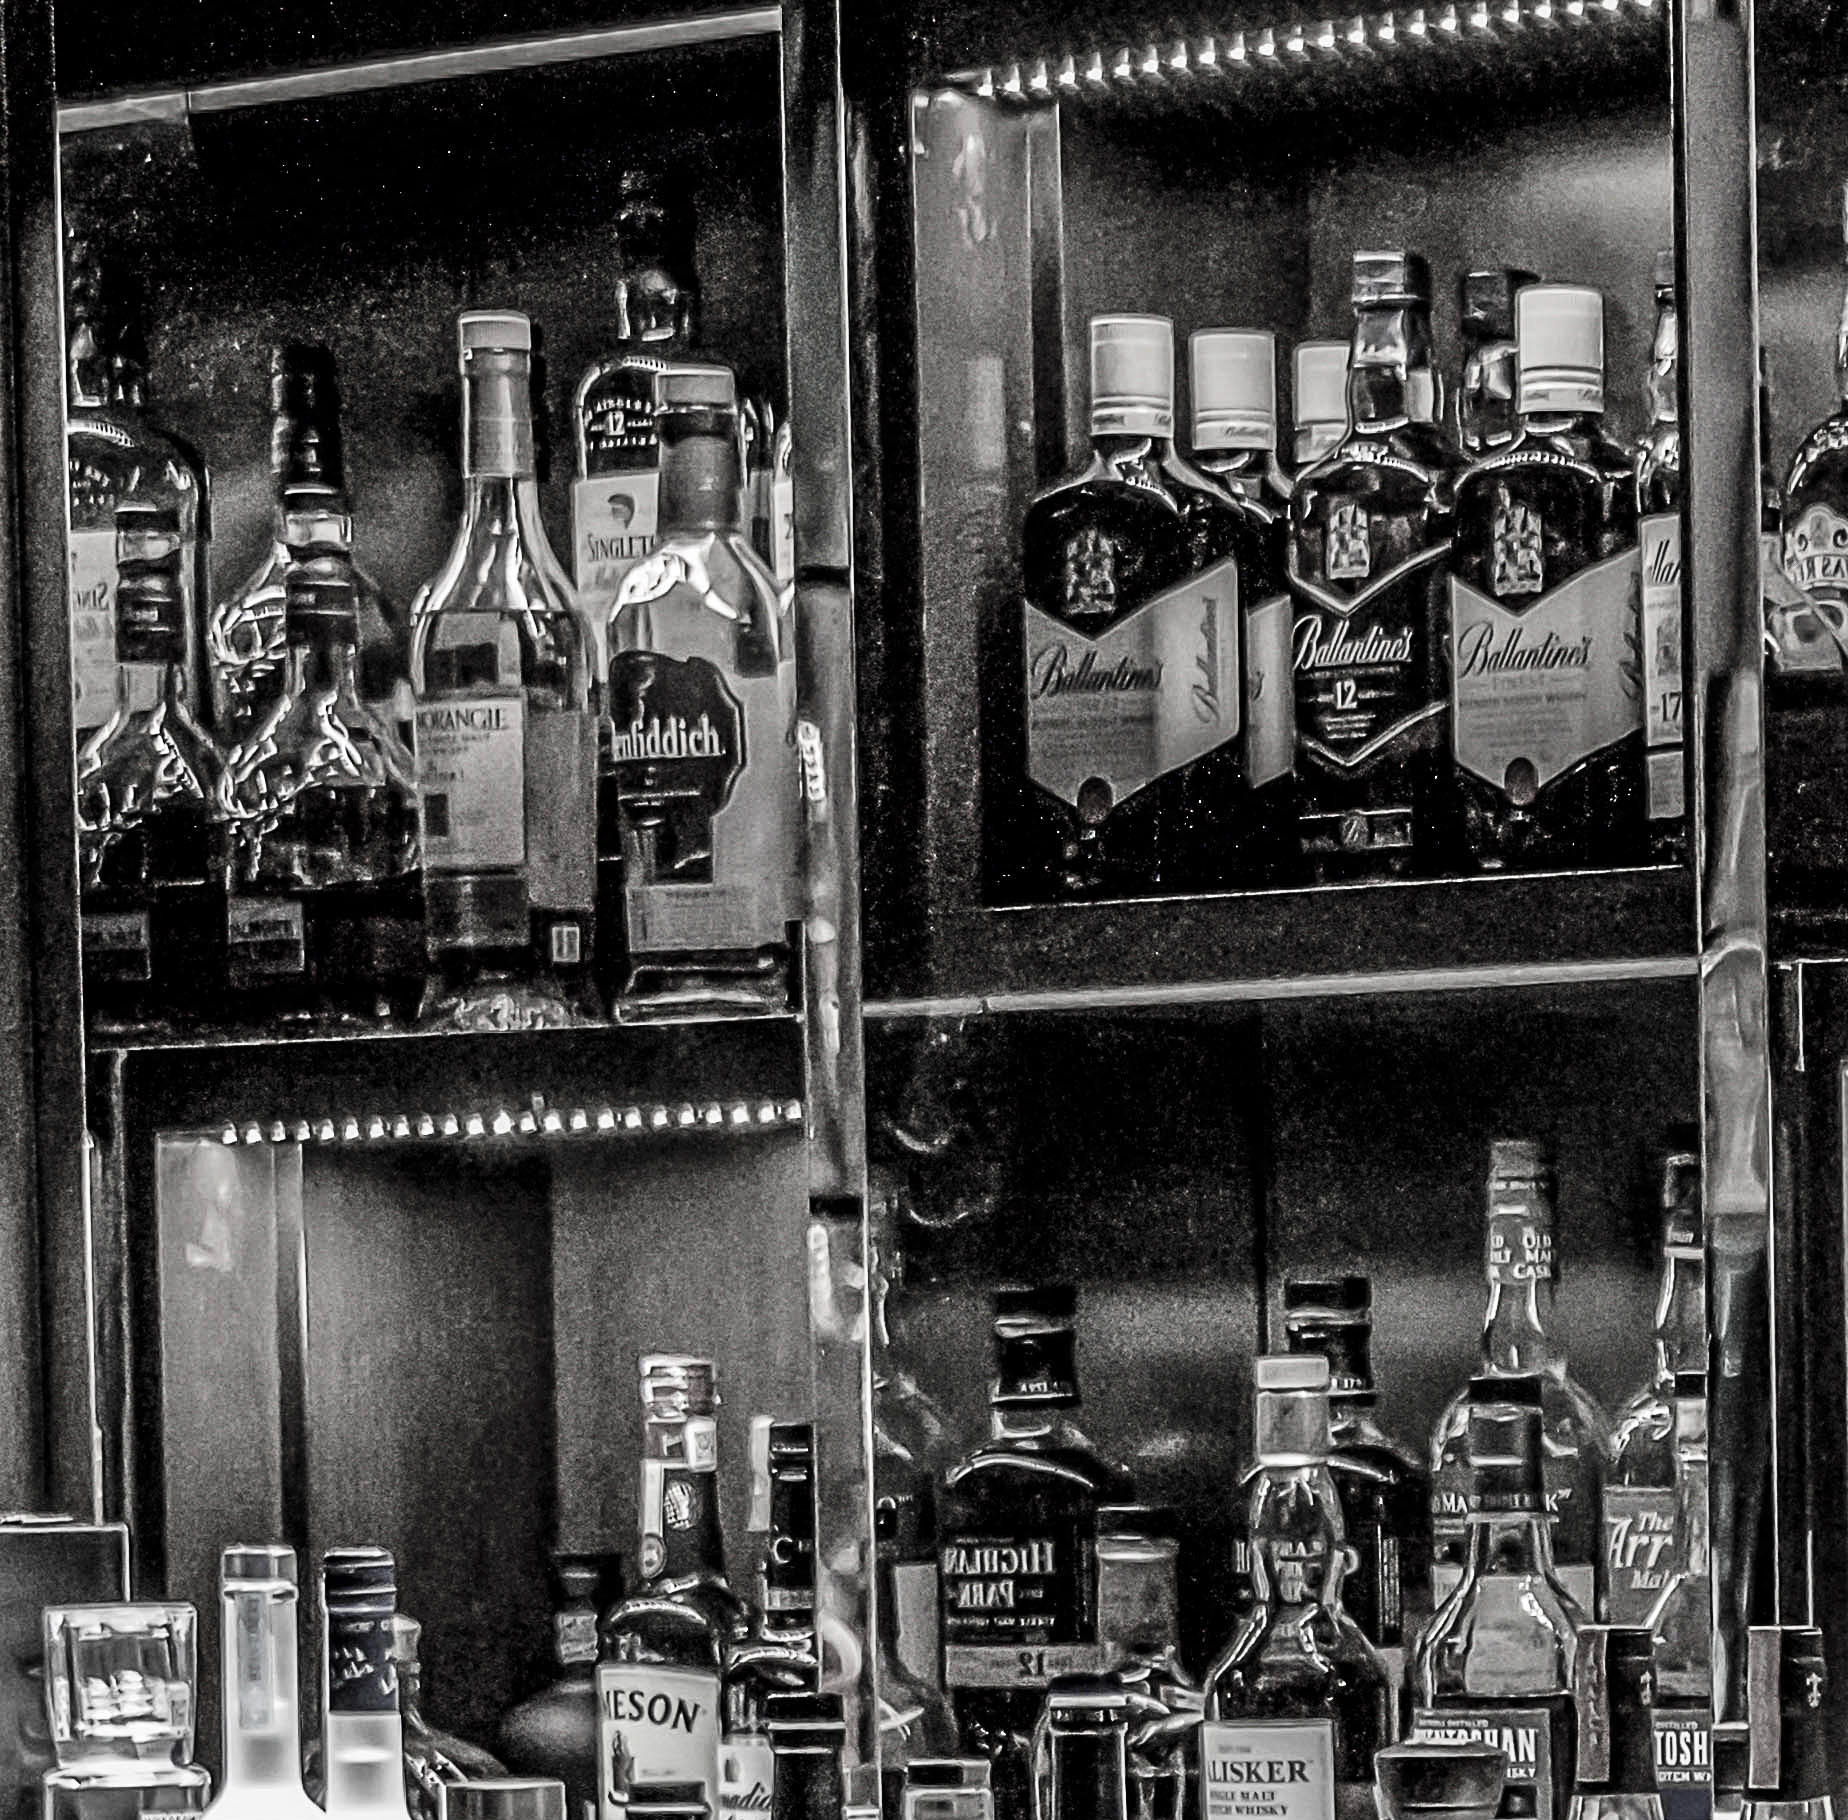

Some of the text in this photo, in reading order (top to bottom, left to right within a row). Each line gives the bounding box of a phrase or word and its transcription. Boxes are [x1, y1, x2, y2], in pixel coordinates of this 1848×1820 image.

[1293, 614, 1413, 671] Ballantine's
[1458, 620, 1592, 680] Ballantine's
[1335, 679, 1358, 709] 12
[1637, 1510, 1674, 1532] The
[1654, 1730, 1709, 1766] TOSH
[1235, 1804, 1289, 1817] WHISKY
